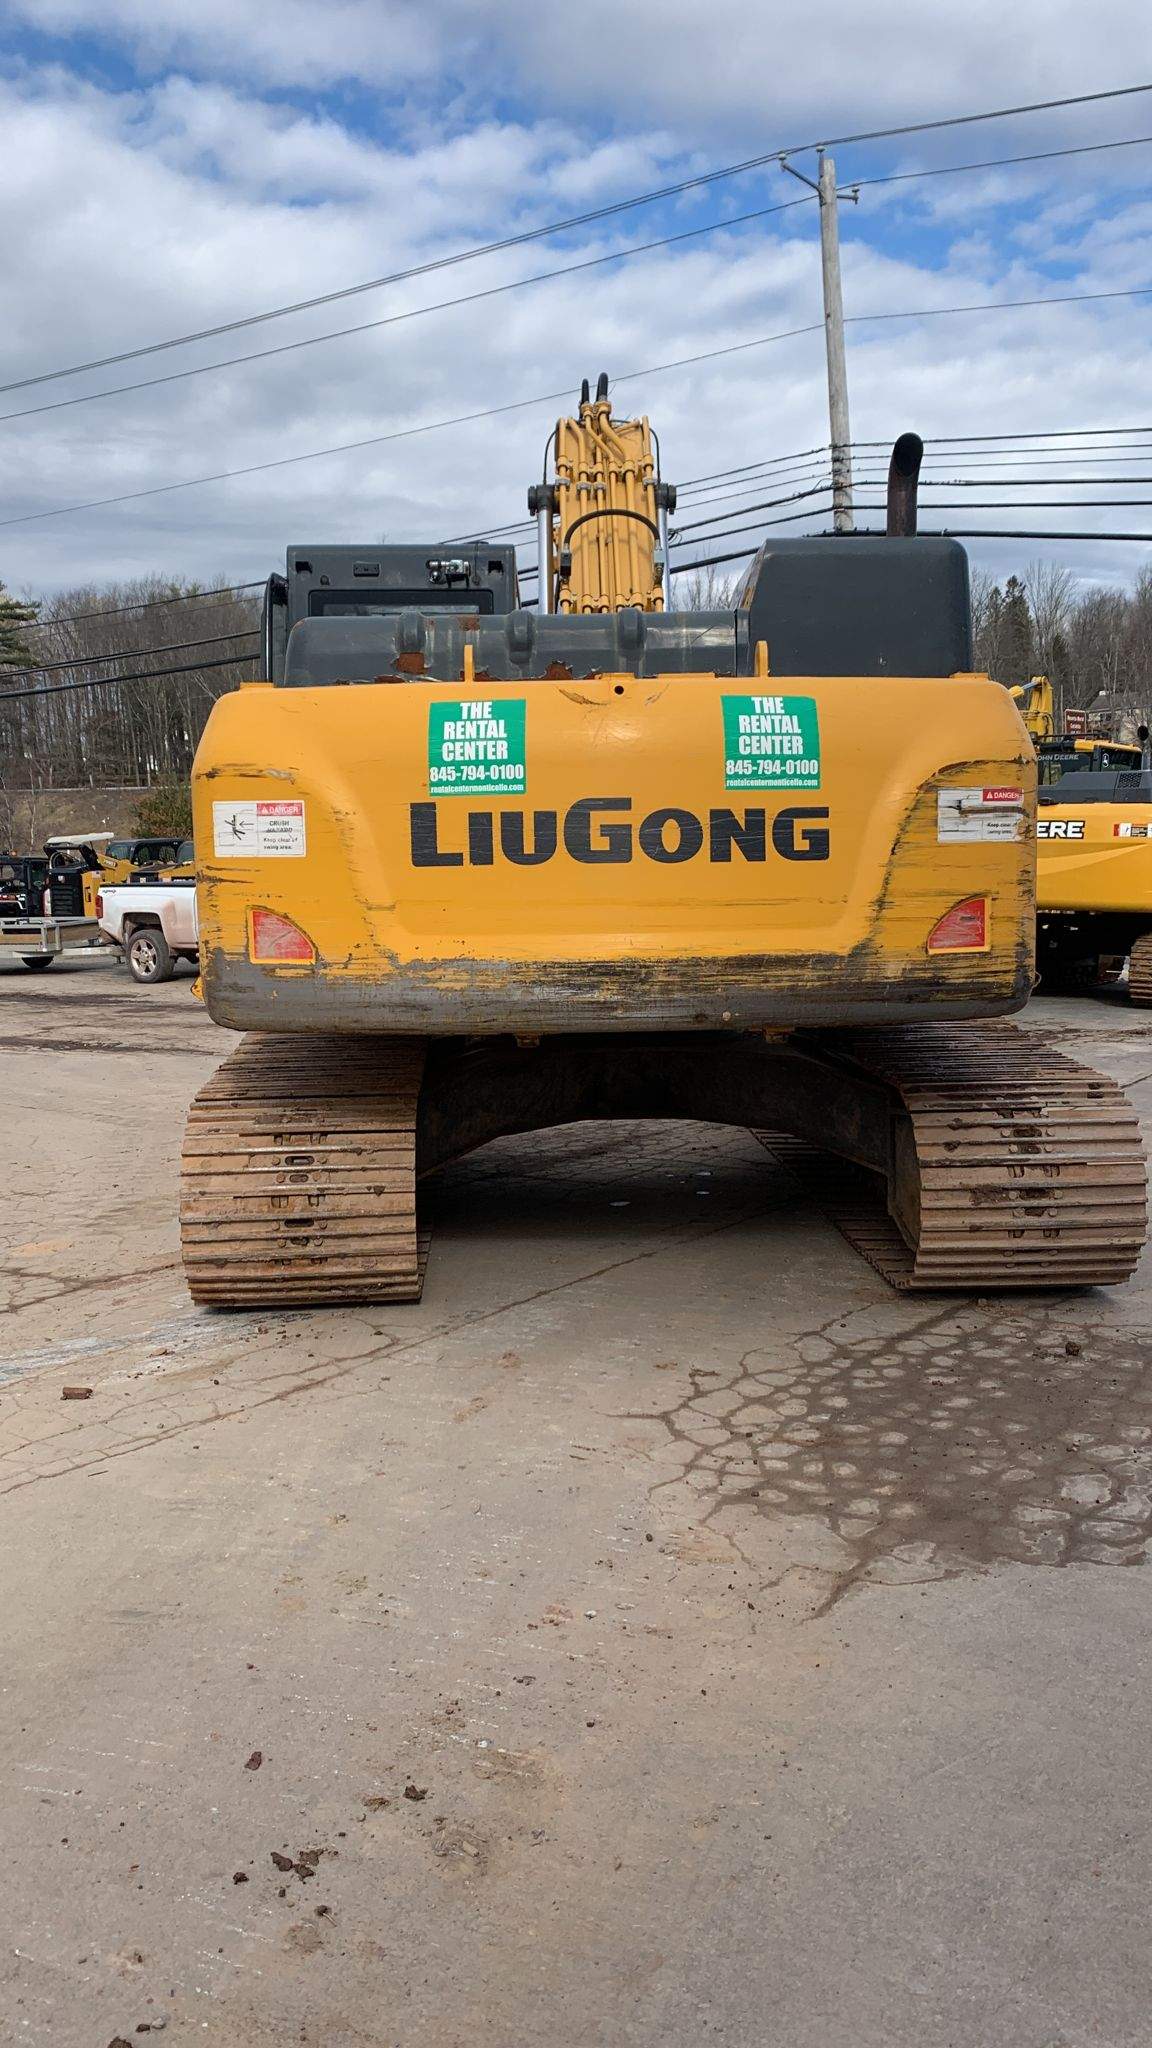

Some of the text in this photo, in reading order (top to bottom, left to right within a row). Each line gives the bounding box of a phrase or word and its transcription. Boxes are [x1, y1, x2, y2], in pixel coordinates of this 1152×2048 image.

[460, 702, 492, 720] THE
[751, 697, 785, 714] THE
[443, 720, 507, 740] RENTAL
[738, 714, 801, 733] RENTAL
[442, 740, 508, 761] CENTER
[738, 734, 803, 755] CENTER
[430, 764, 523, 782] 845-794-0100
[726, 759, 818, 775] 845-794-0100
[430, 784, 524, 793] rentalcentermonticello.com
[726, 778, 818, 786] rentalcentermonticello.com
[269, 806, 298, 814] DANGER
